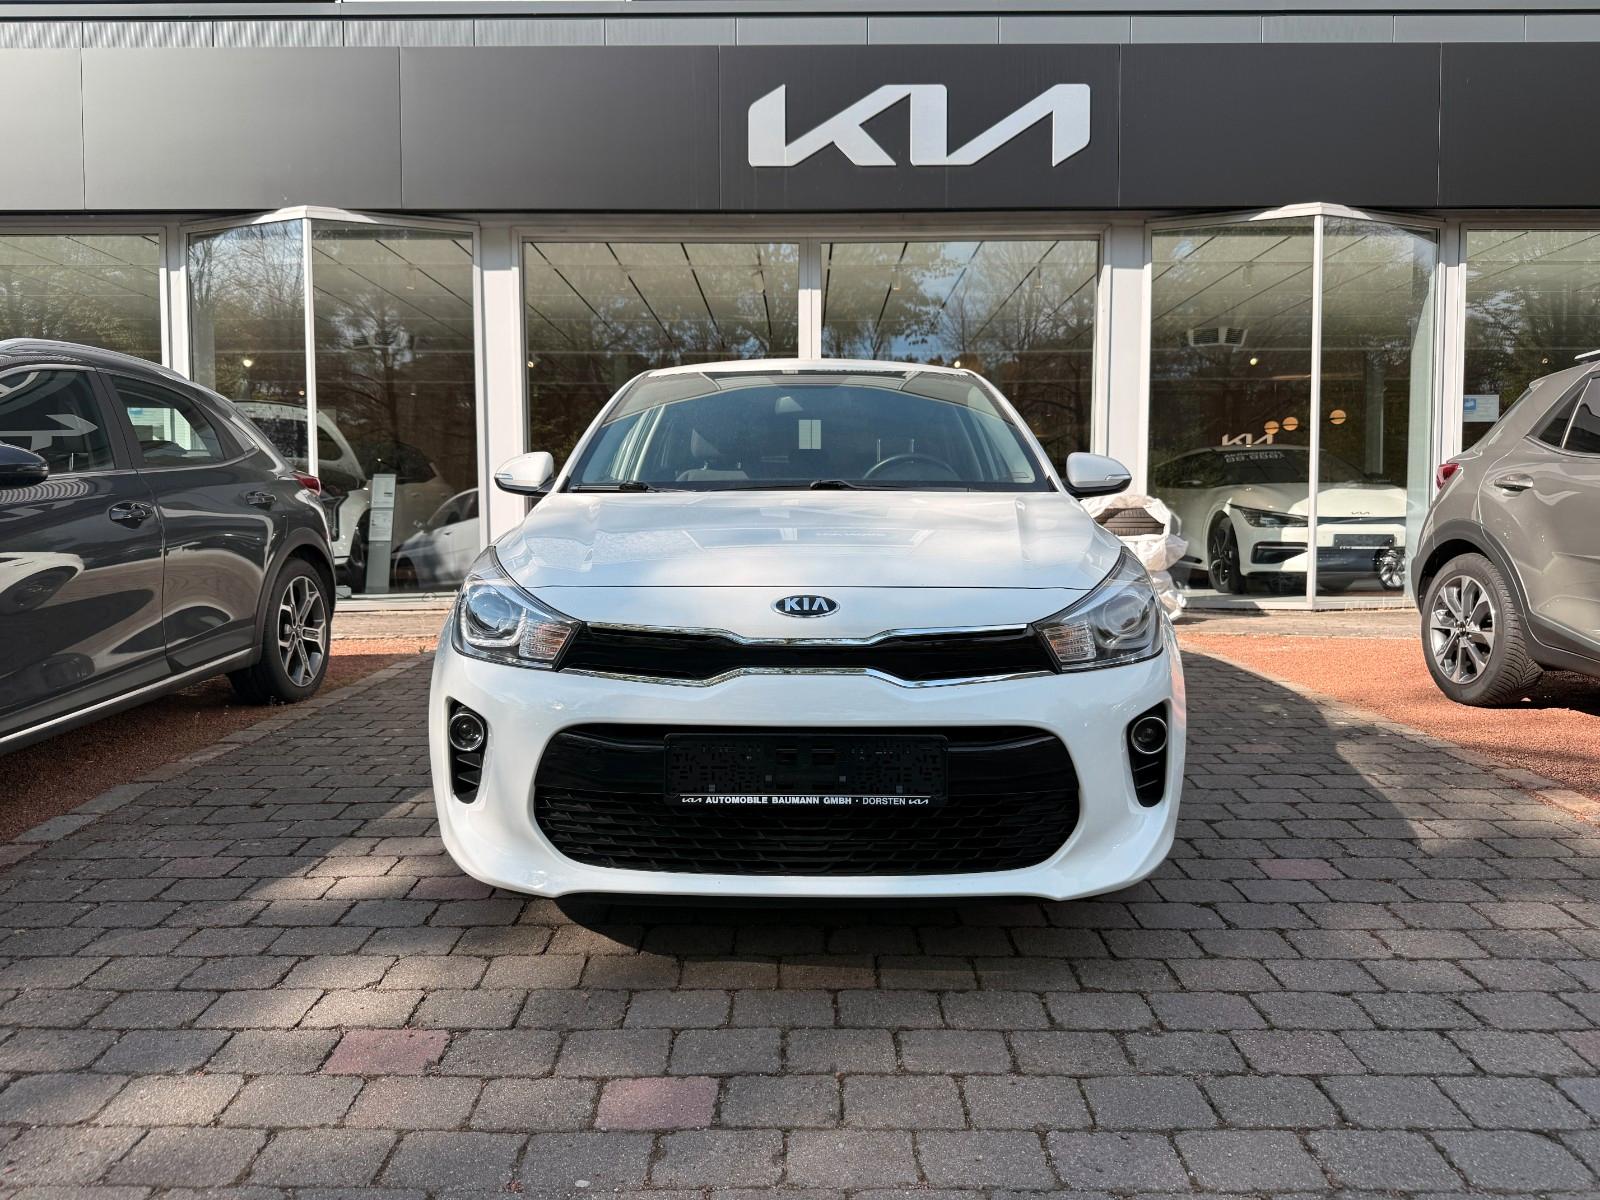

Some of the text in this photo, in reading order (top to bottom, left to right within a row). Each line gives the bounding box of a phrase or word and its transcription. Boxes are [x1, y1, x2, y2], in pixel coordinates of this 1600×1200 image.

[748, 84, 1091, 168] KIA
[783, 597, 830, 612] KIA
[705, 796, 768, 804] AUTOMOBILE
[771, 796, 820, 804] BAUMANN
[823, 797, 852, 805] GMBH
[862, 797, 906, 805] DORSTEN
